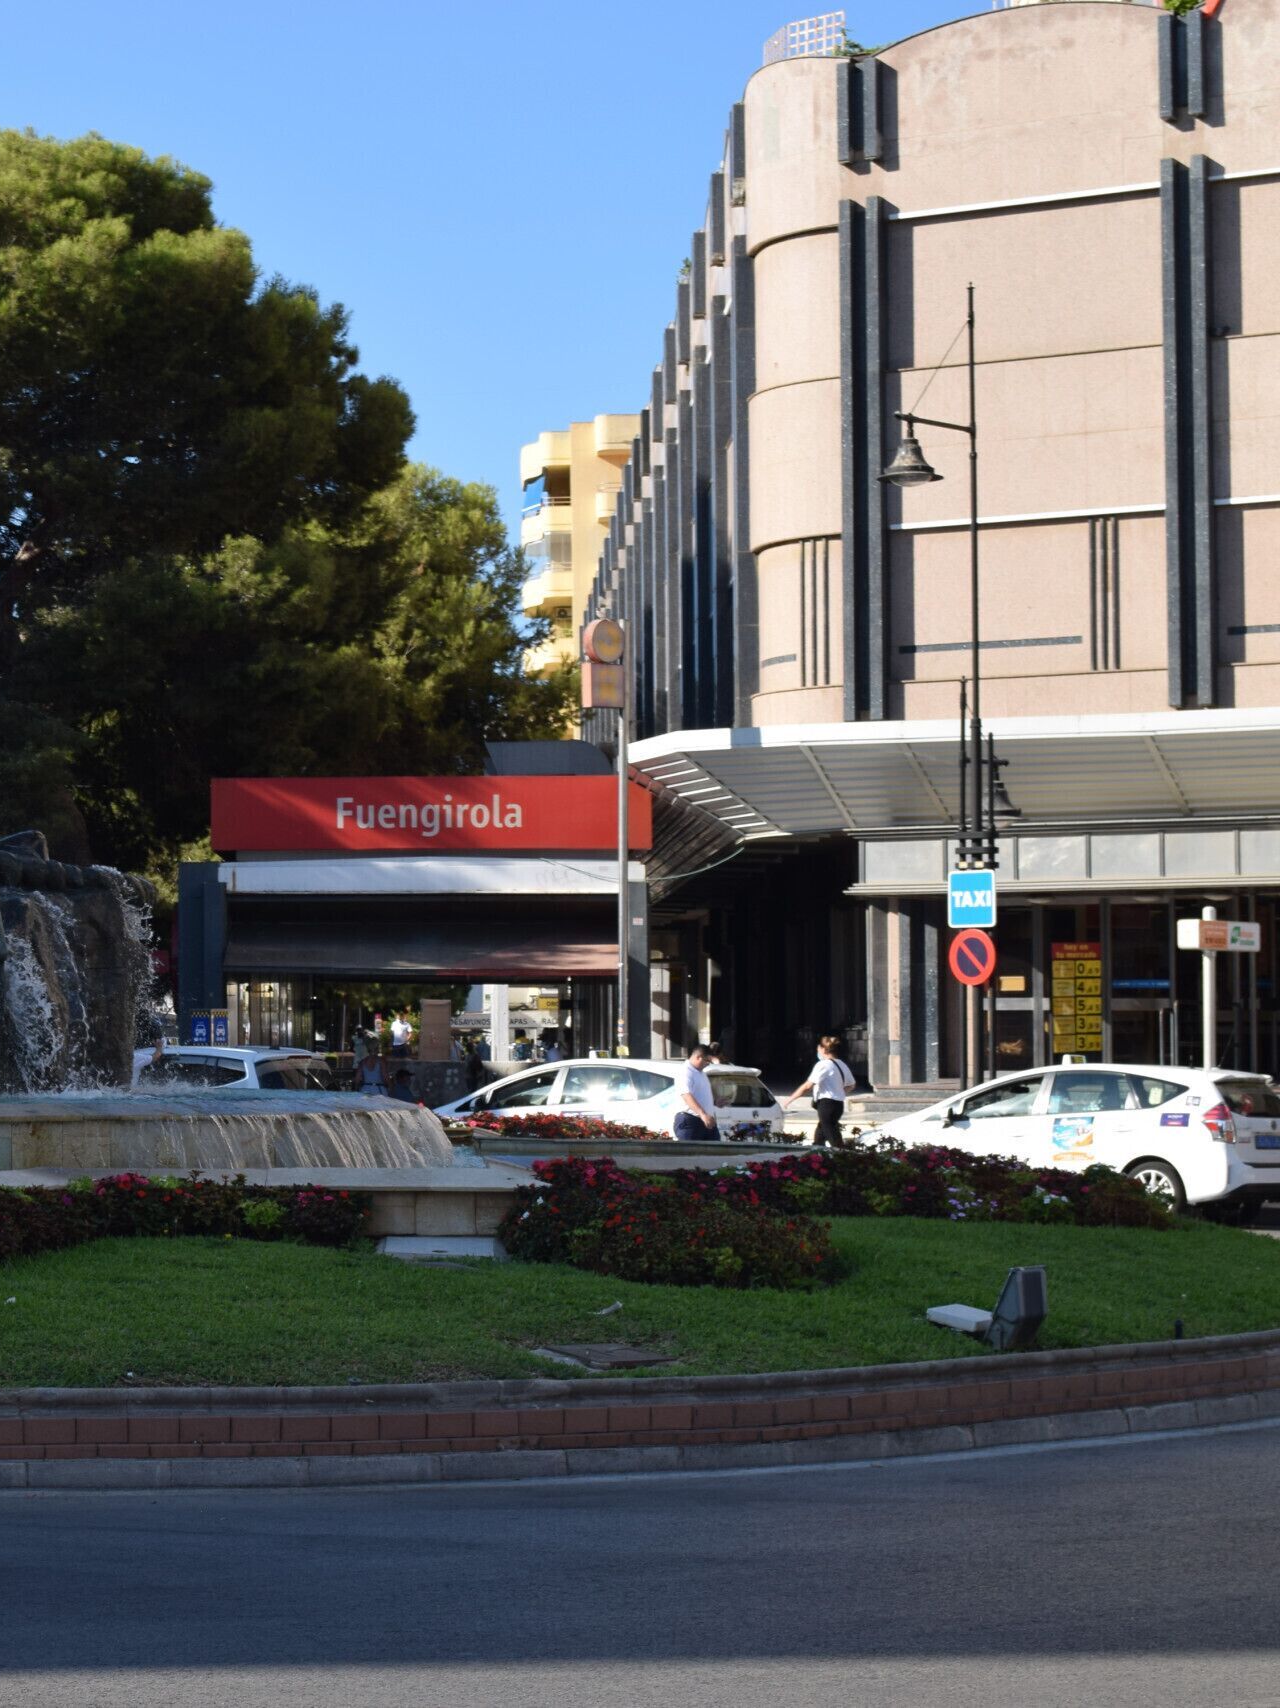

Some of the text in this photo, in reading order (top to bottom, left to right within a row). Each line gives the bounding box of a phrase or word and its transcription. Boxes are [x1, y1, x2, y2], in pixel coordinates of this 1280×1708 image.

[336, 794, 523, 837] Fuengirola
[952, 890, 991, 908] TAXI
[449, 1018, 491, 1026] DESAYUNOS
